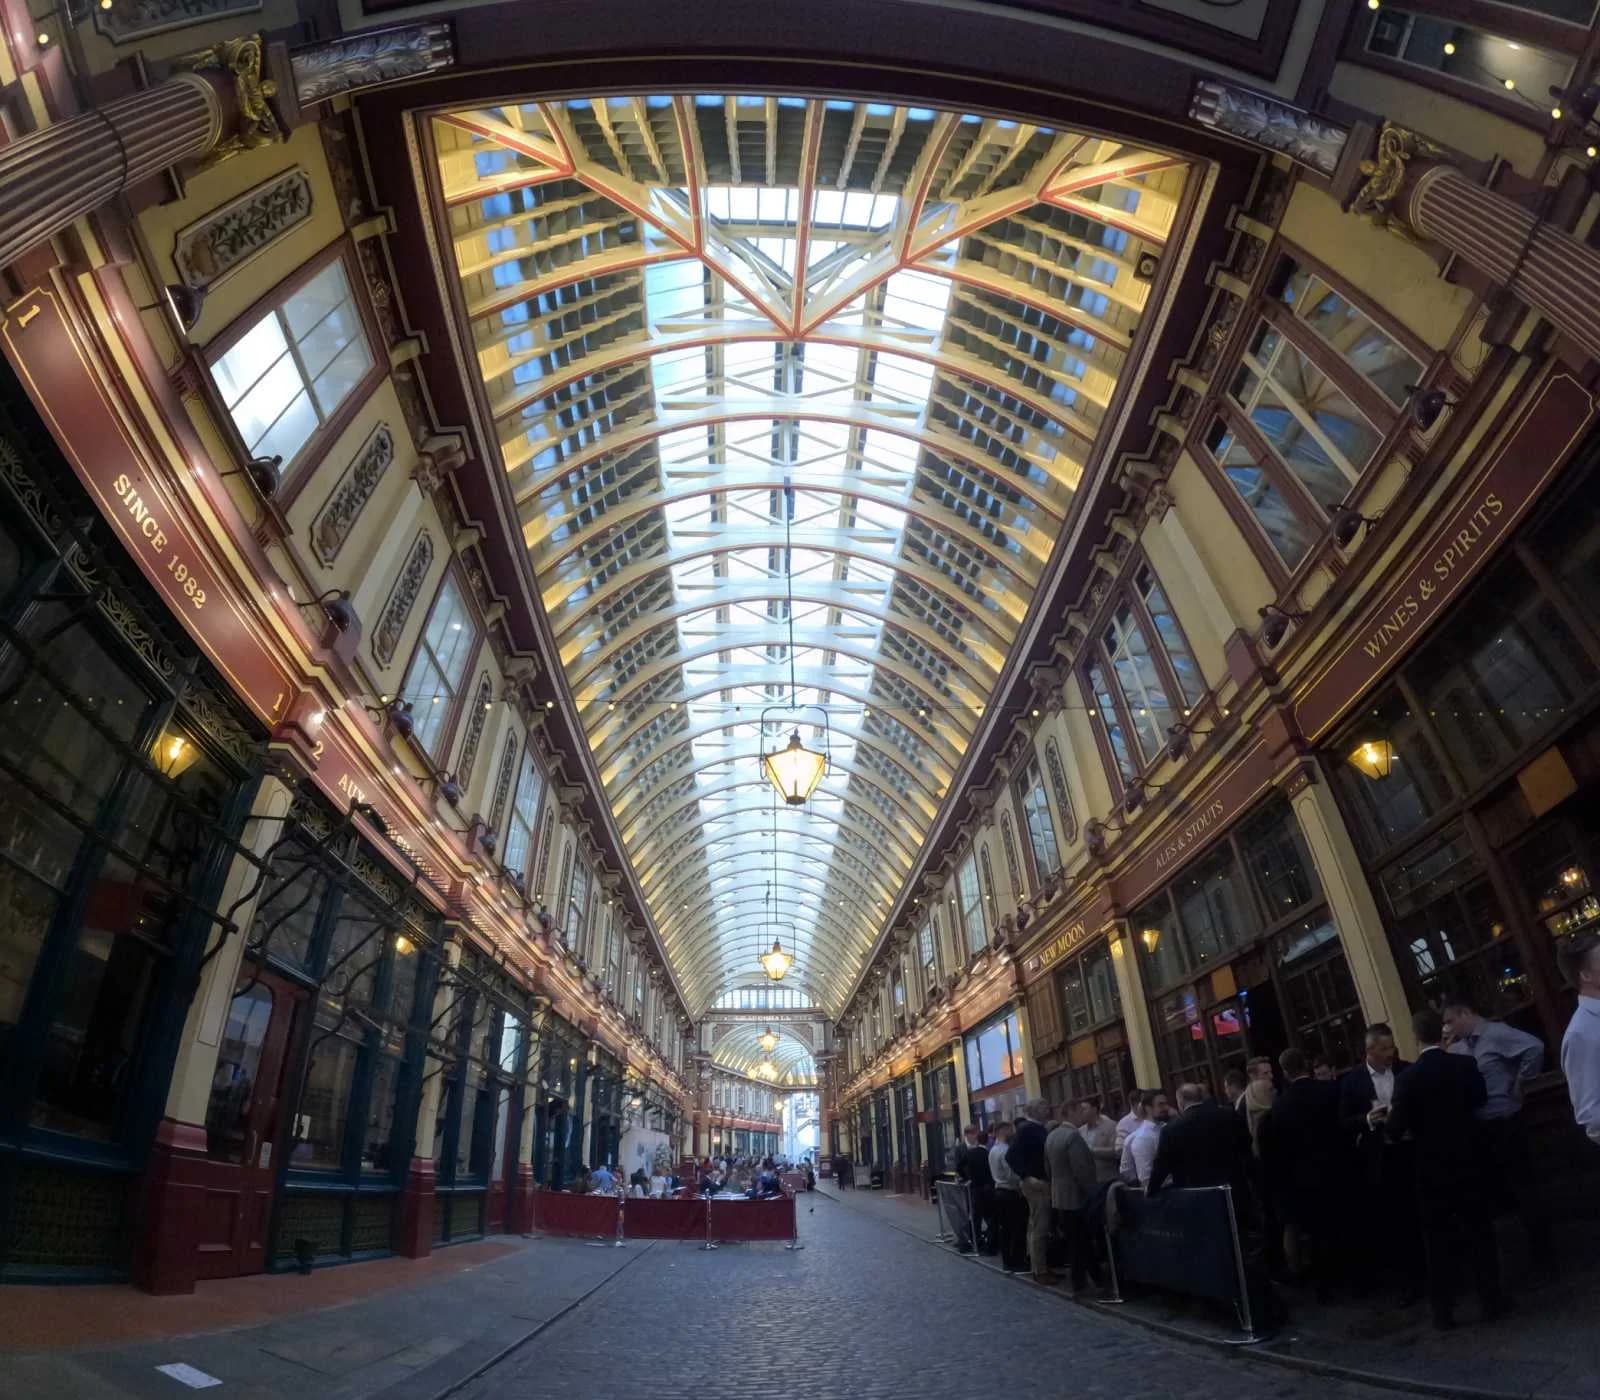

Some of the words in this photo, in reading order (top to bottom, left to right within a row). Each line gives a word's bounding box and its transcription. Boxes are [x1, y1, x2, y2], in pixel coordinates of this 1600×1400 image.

[18, 304, 40, 329] 1
[112, 474, 168, 554] SINCE
[166, 555, 207, 609] 1982
[1363, 596, 1419, 659] WINES
[1419, 579, 1436, 600] &
[1434, 493, 1503, 581] SPIRITS
[272, 693, 284, 712] 1
[312, 740, 324, 761] 2
[1155, 846, 1177, 873] ALES
[1186, 799, 1224, 842] STOUTS
[1040, 942, 1057, 966] NEW
[1057, 920, 1086, 954] MOON
